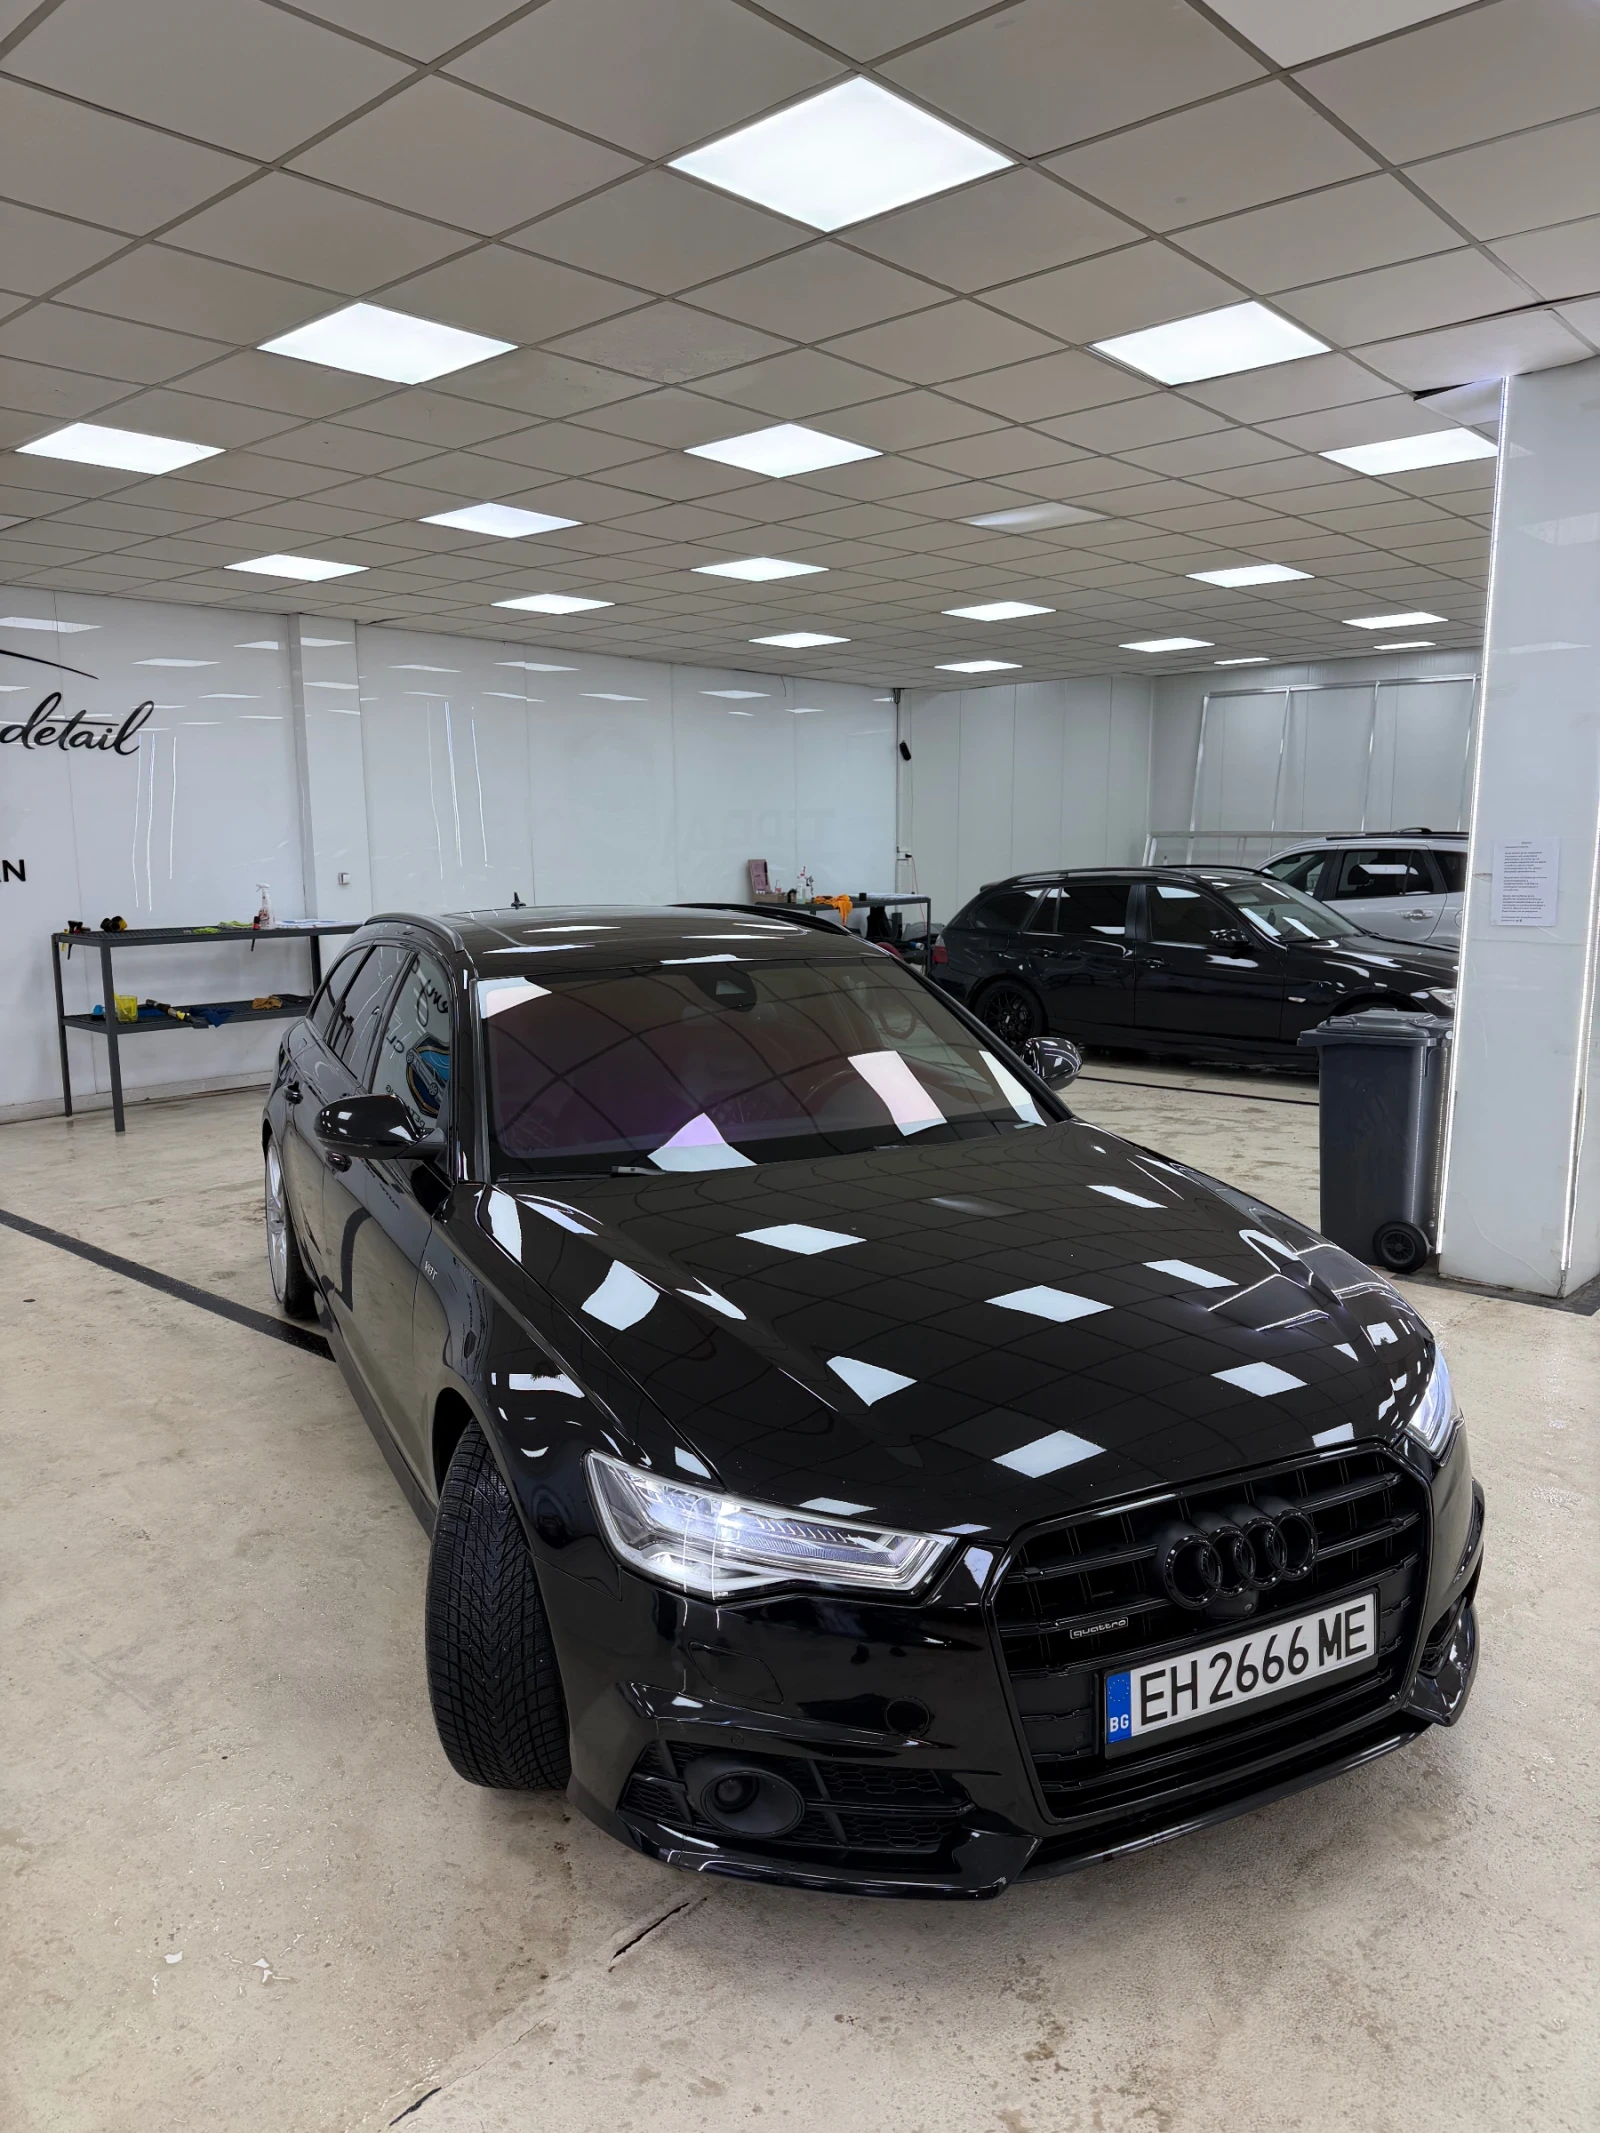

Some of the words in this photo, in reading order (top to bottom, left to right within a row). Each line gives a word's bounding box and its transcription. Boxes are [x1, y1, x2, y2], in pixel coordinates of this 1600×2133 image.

[0, 691, 154, 755] detail
[1073, 1619, 1127, 1637] quattro
[1140, 1660, 1198, 1726] EH
[1208, 1625, 1309, 1704] 2666
[1318, 1603, 1367, 1667] ME
[1109, 1713, 1130, 1733] BG
